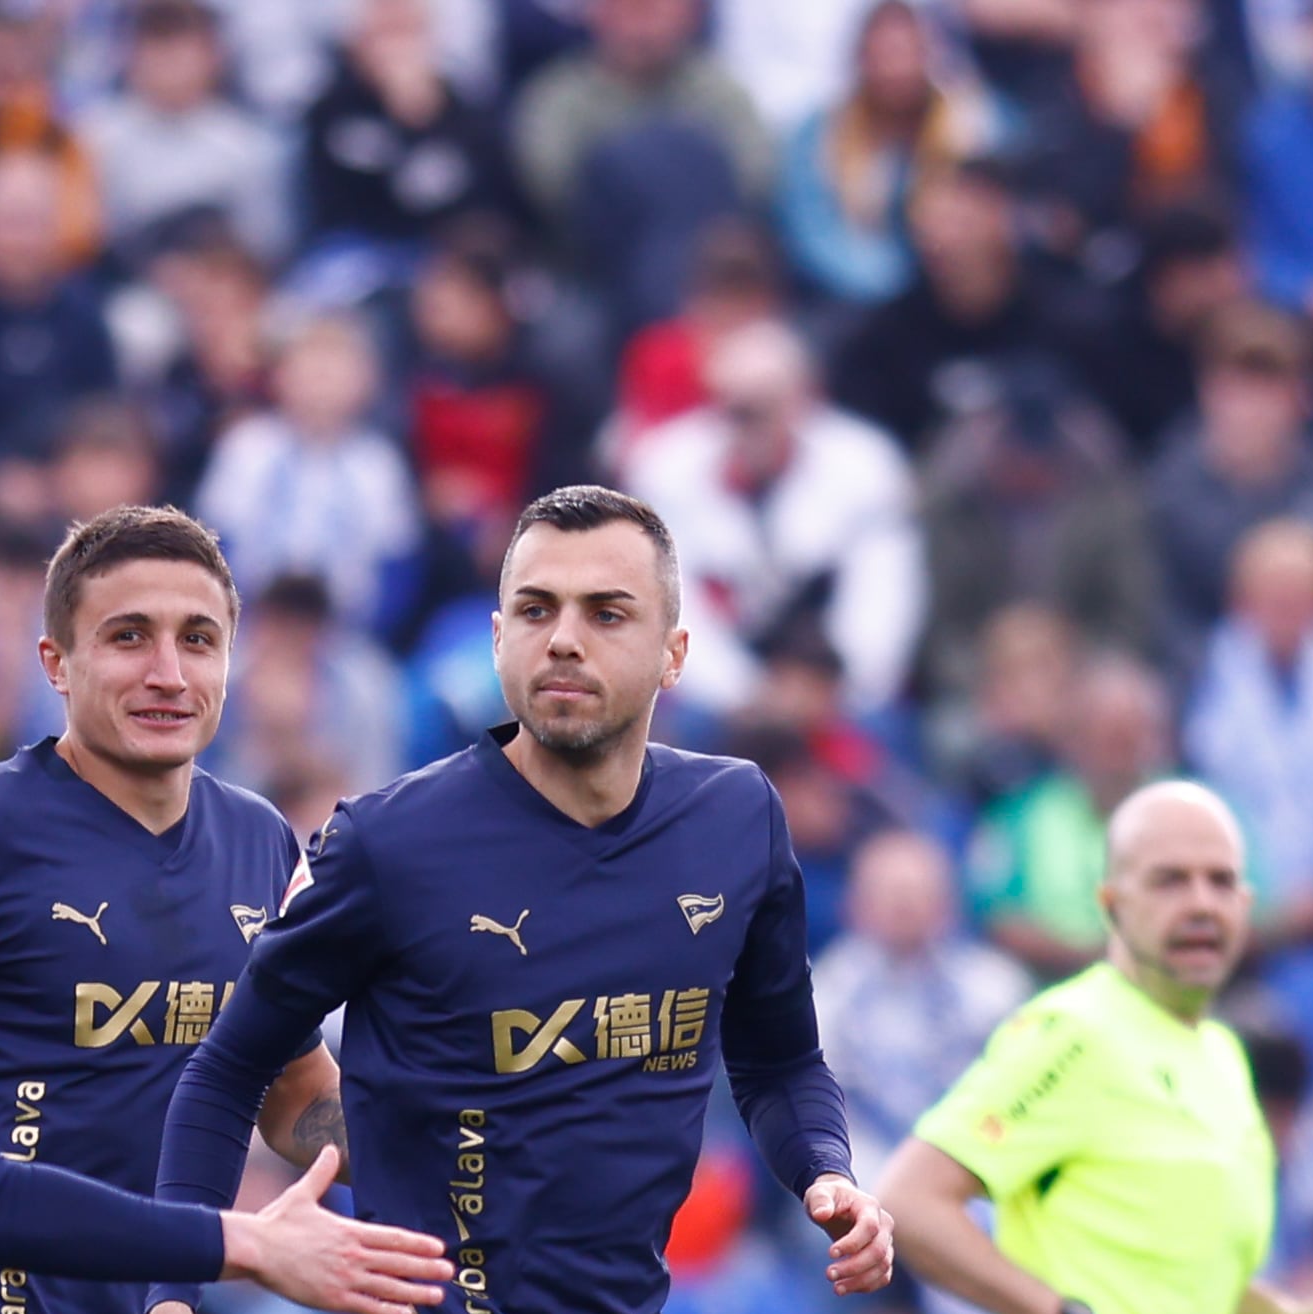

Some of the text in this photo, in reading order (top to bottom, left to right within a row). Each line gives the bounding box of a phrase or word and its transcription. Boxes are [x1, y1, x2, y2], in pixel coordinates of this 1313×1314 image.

[162, 980, 236, 1045] 德
[592, 987, 710, 1060] 德信
[642, 1050, 698, 1073] NEWS
[0, 1080, 46, 1163] lava
